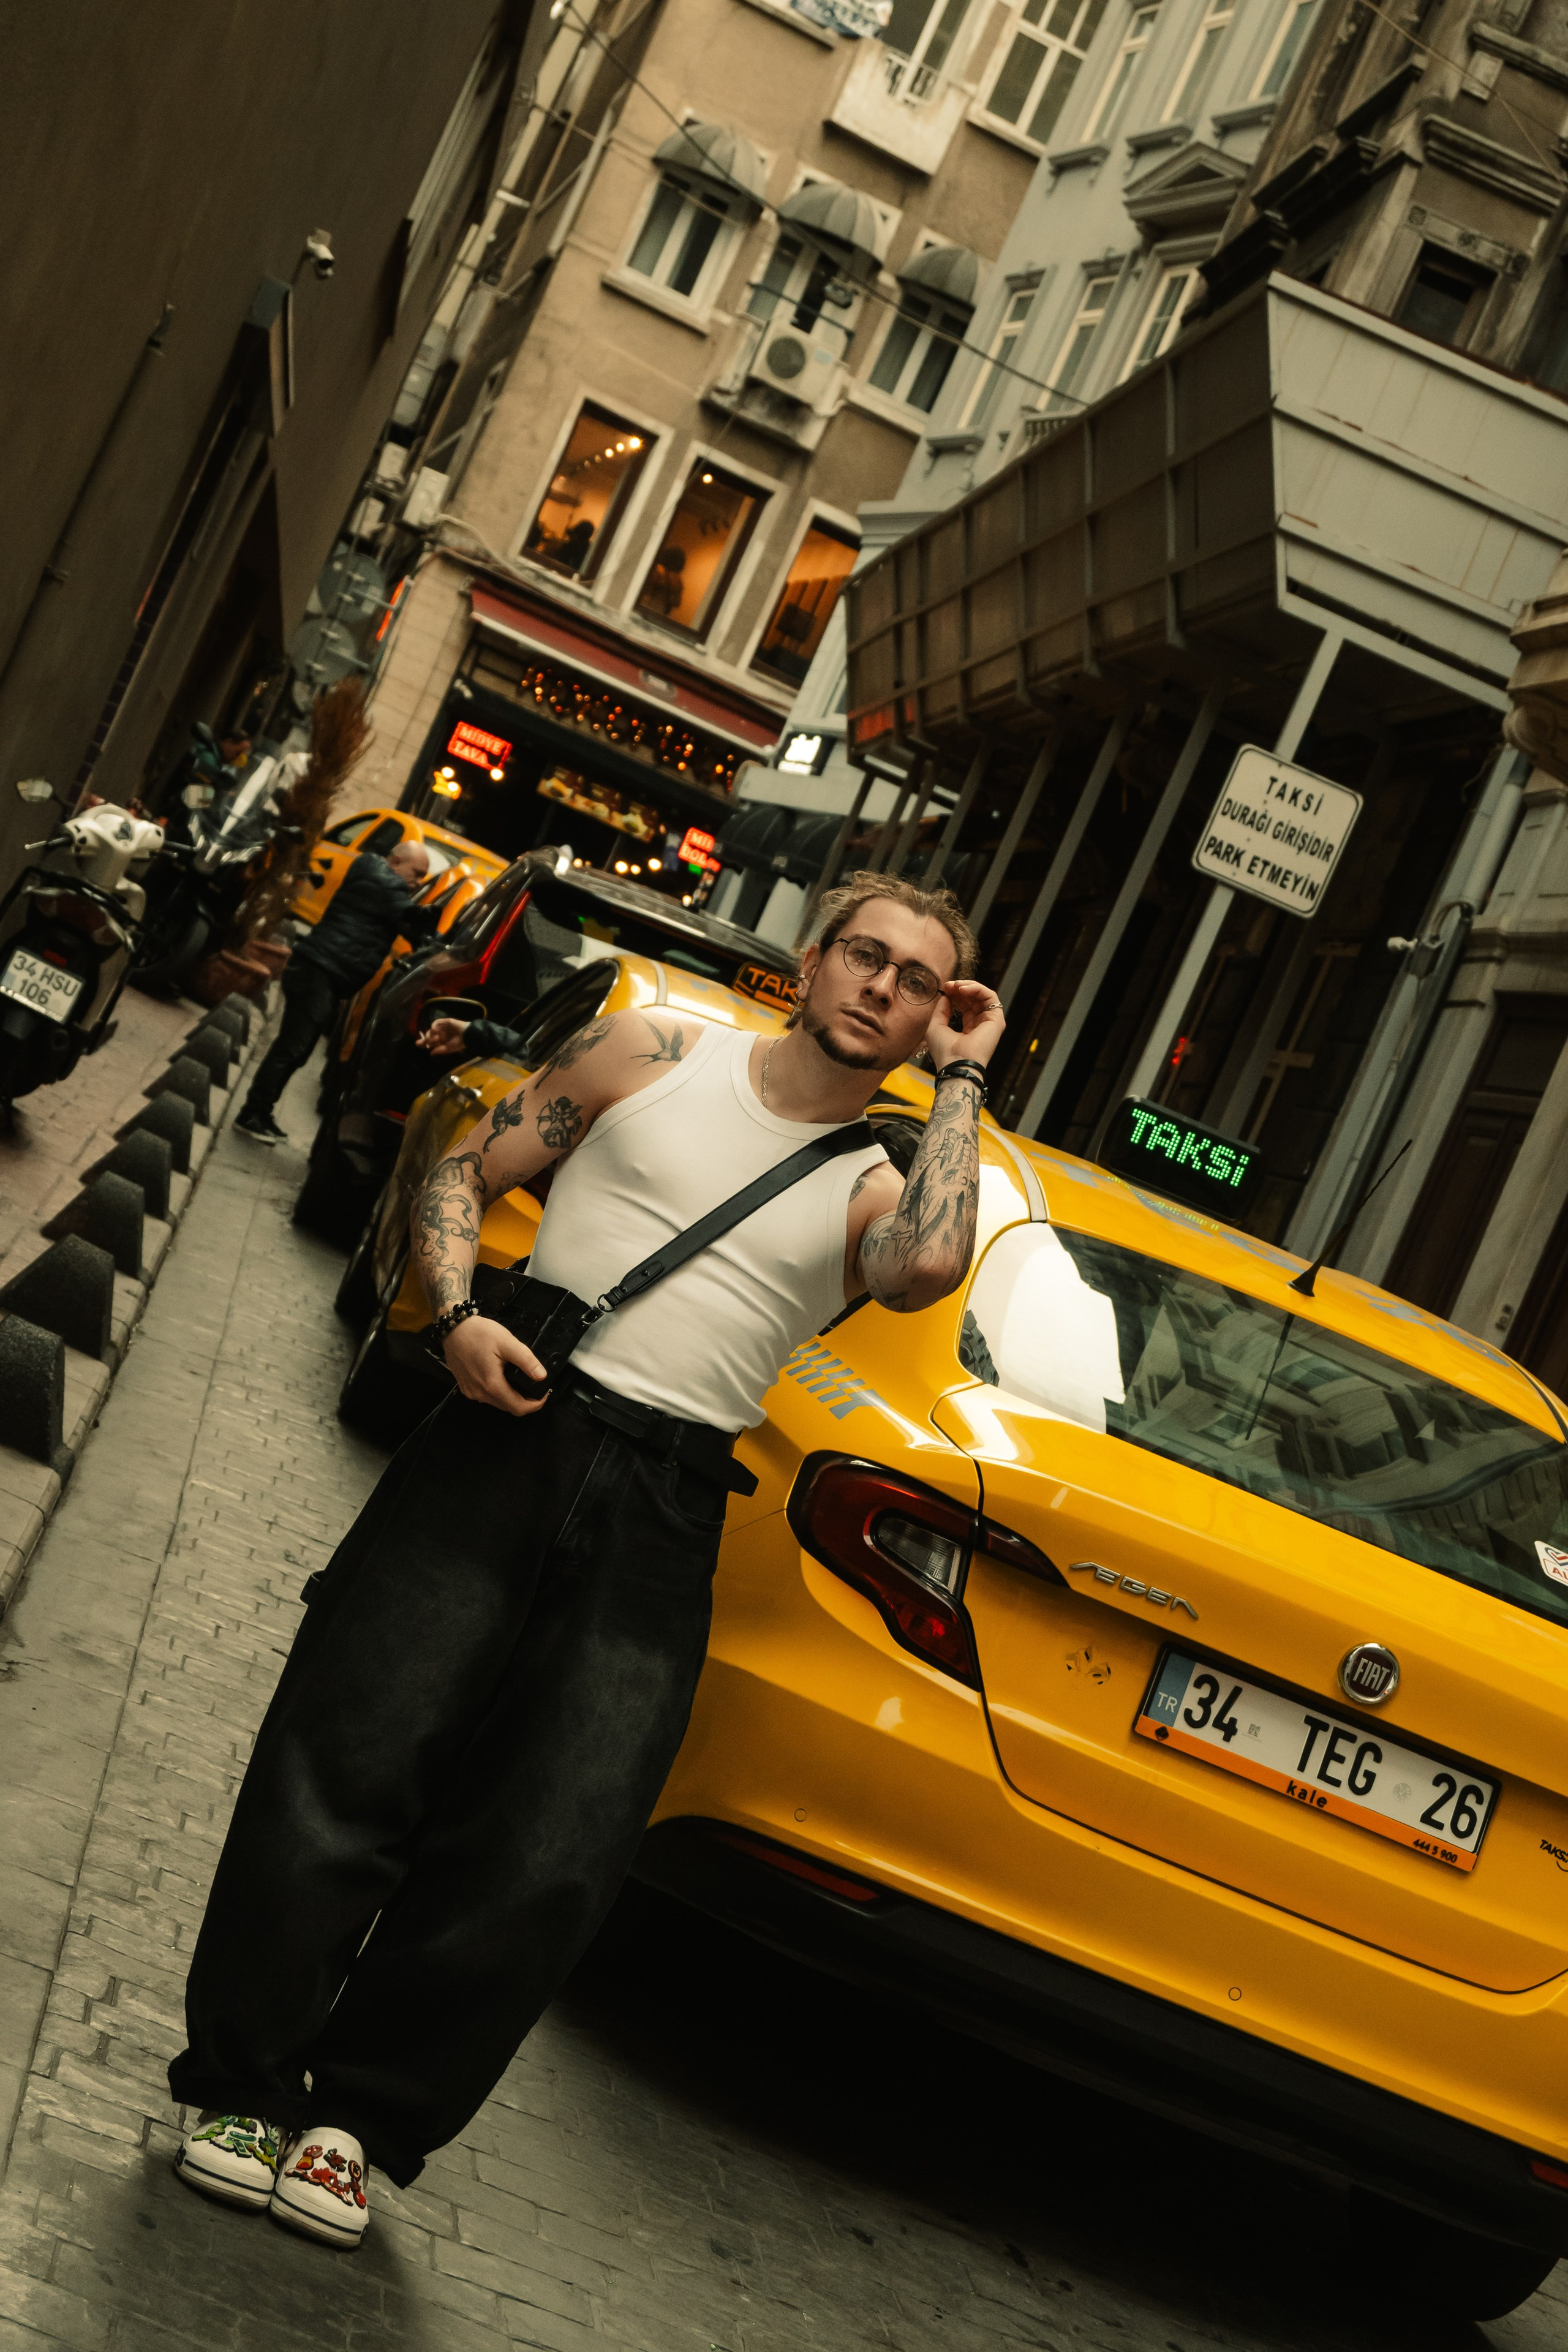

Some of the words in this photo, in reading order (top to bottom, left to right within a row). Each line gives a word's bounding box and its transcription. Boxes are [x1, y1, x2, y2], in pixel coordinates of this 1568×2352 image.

[453, 741, 486, 764] TAVA
[1266, 775, 1324, 816] TAKSİ
[1220, 797, 1273, 834] DURAĞI
[1272, 819, 1335, 862] GİRİŞİDİR
[1204, 835, 1246, 869] PARK
[1246, 854, 1320, 901] ETMEYİN
[13, 956, 37, 976] 34
[39, 968, 78, 997] HSU
[19, 979, 52, 1005] 106
[1352, 1657, 1390, 1691] FIAT
[1156, 1691, 1178, 1714] TR
[1183, 1673, 1243, 1743] 34
[1297, 1714, 1383, 1796] TEG
[1419, 1773, 1485, 1839] 26
[1286, 1780, 1328, 1808] kale
[1413, 1839, 1431, 1852] 444
[1432, 1845, 1439, 1855] 5
[1441, 1850, 1458, 1863] 900
[1539, 1839, 1568, 1863] TAKS
